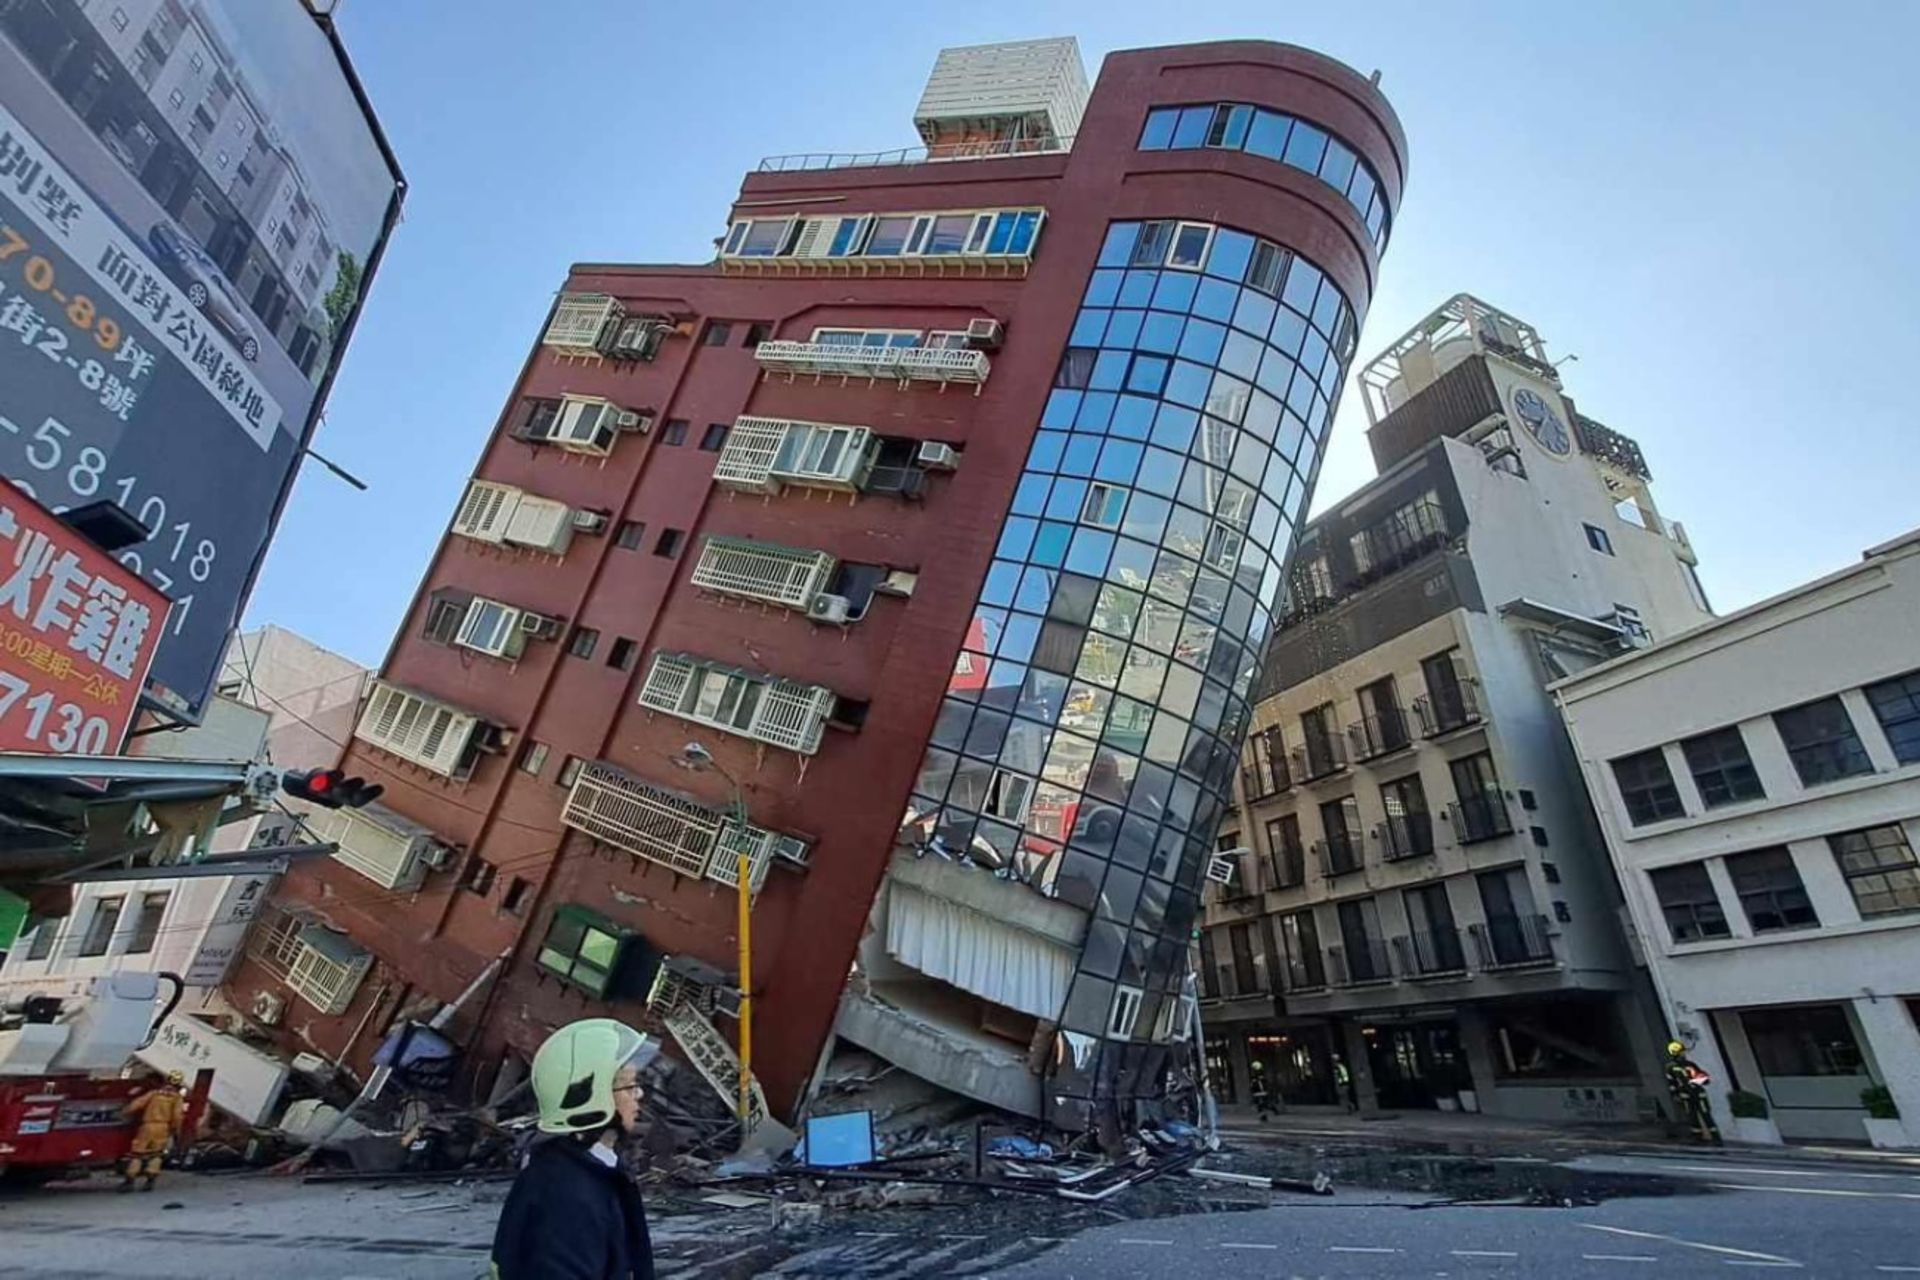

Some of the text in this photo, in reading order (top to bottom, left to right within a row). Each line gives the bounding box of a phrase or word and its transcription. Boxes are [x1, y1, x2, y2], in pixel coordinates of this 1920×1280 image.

[0, 223, 156, 380] 70-89坪
[0, 280, 137, 420] 街2-8號
[97, 240, 264, 430] 面對公園綠地
[0, 624, 121, 705] :00星期一公休
